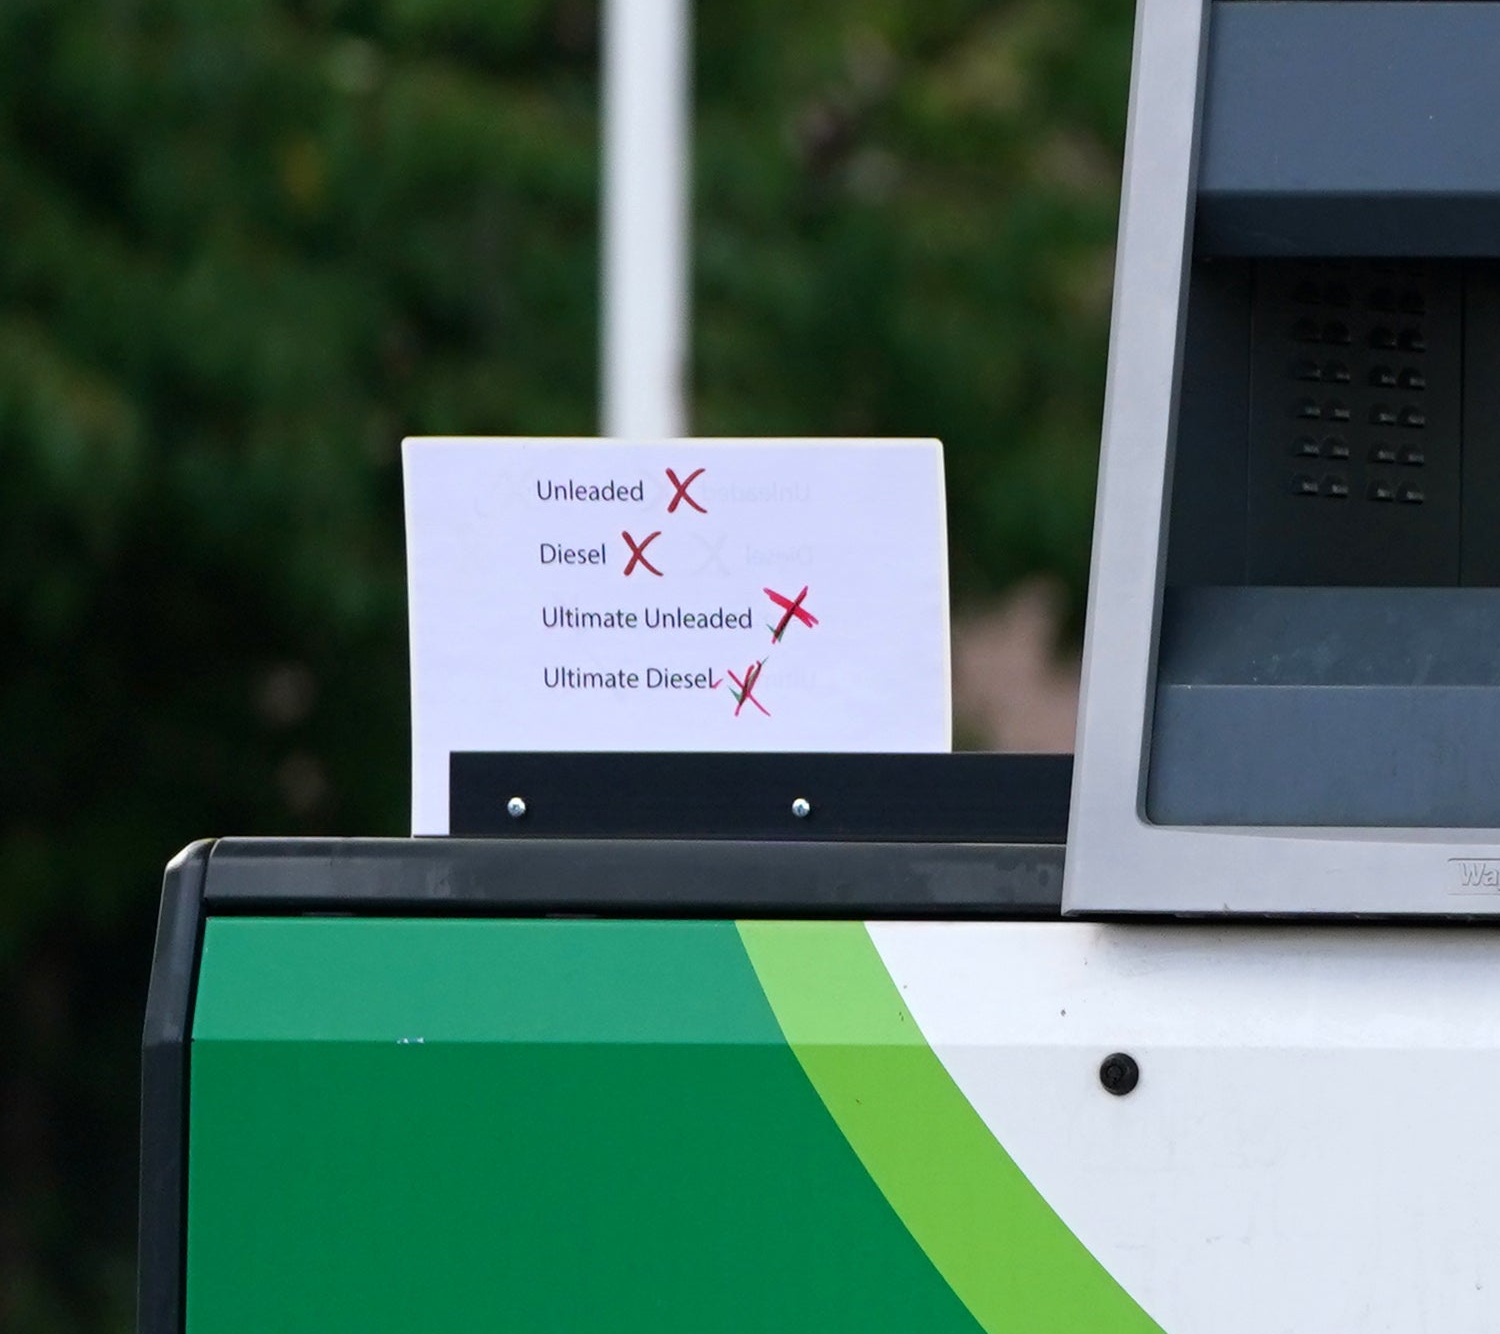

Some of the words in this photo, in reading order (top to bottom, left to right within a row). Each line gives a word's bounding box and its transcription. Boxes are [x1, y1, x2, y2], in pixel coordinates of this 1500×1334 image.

[536, 479, 644, 502] Unleaded
[540, 543, 606, 564] Diesel
[542, 607, 637, 628] Ultimate
[644, 607, 752, 629] Unleaded
[543, 667, 639, 688] Ultimate
[646, 667, 715, 689] Diesel
